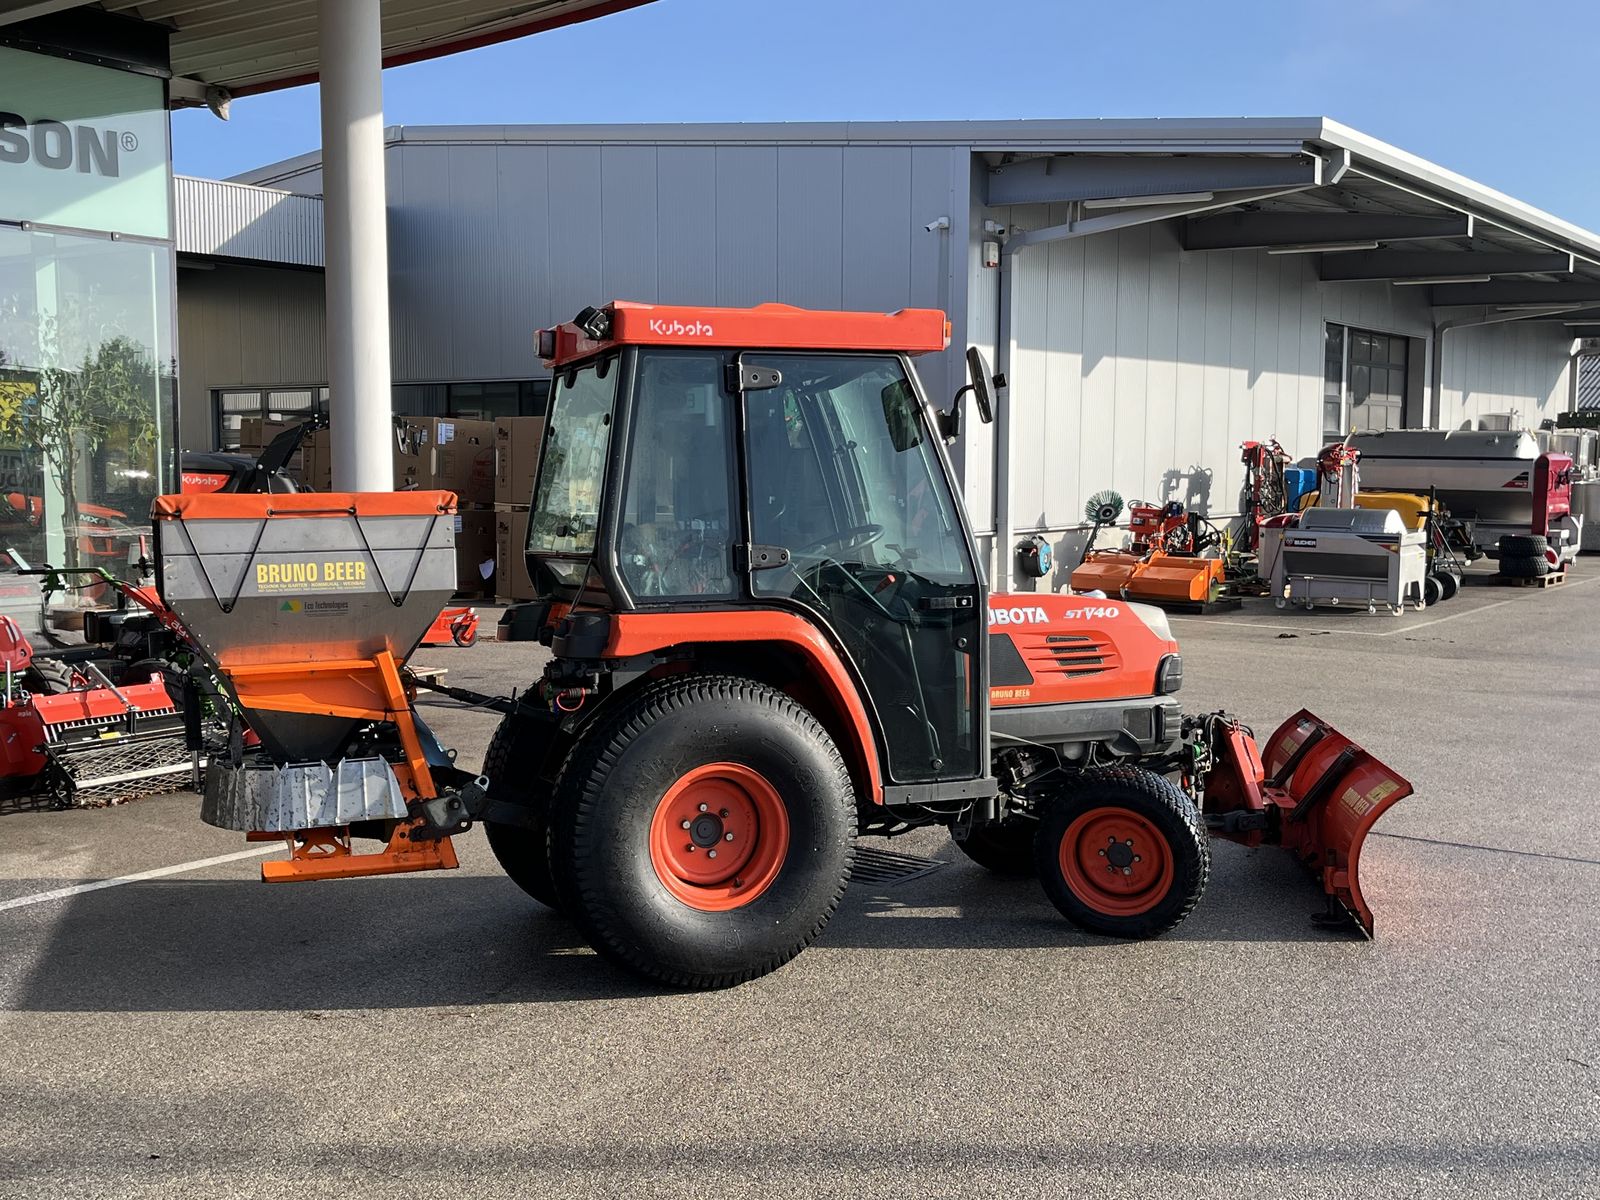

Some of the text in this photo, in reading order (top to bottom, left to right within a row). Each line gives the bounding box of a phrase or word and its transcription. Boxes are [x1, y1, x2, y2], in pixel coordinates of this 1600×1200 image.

[649, 319, 713, 336] Kubota
[182, 475, 218, 486] Kubota
[256, 561, 366, 583] BRUNO BEER
[991, 689, 1013, 698] BRUNO
